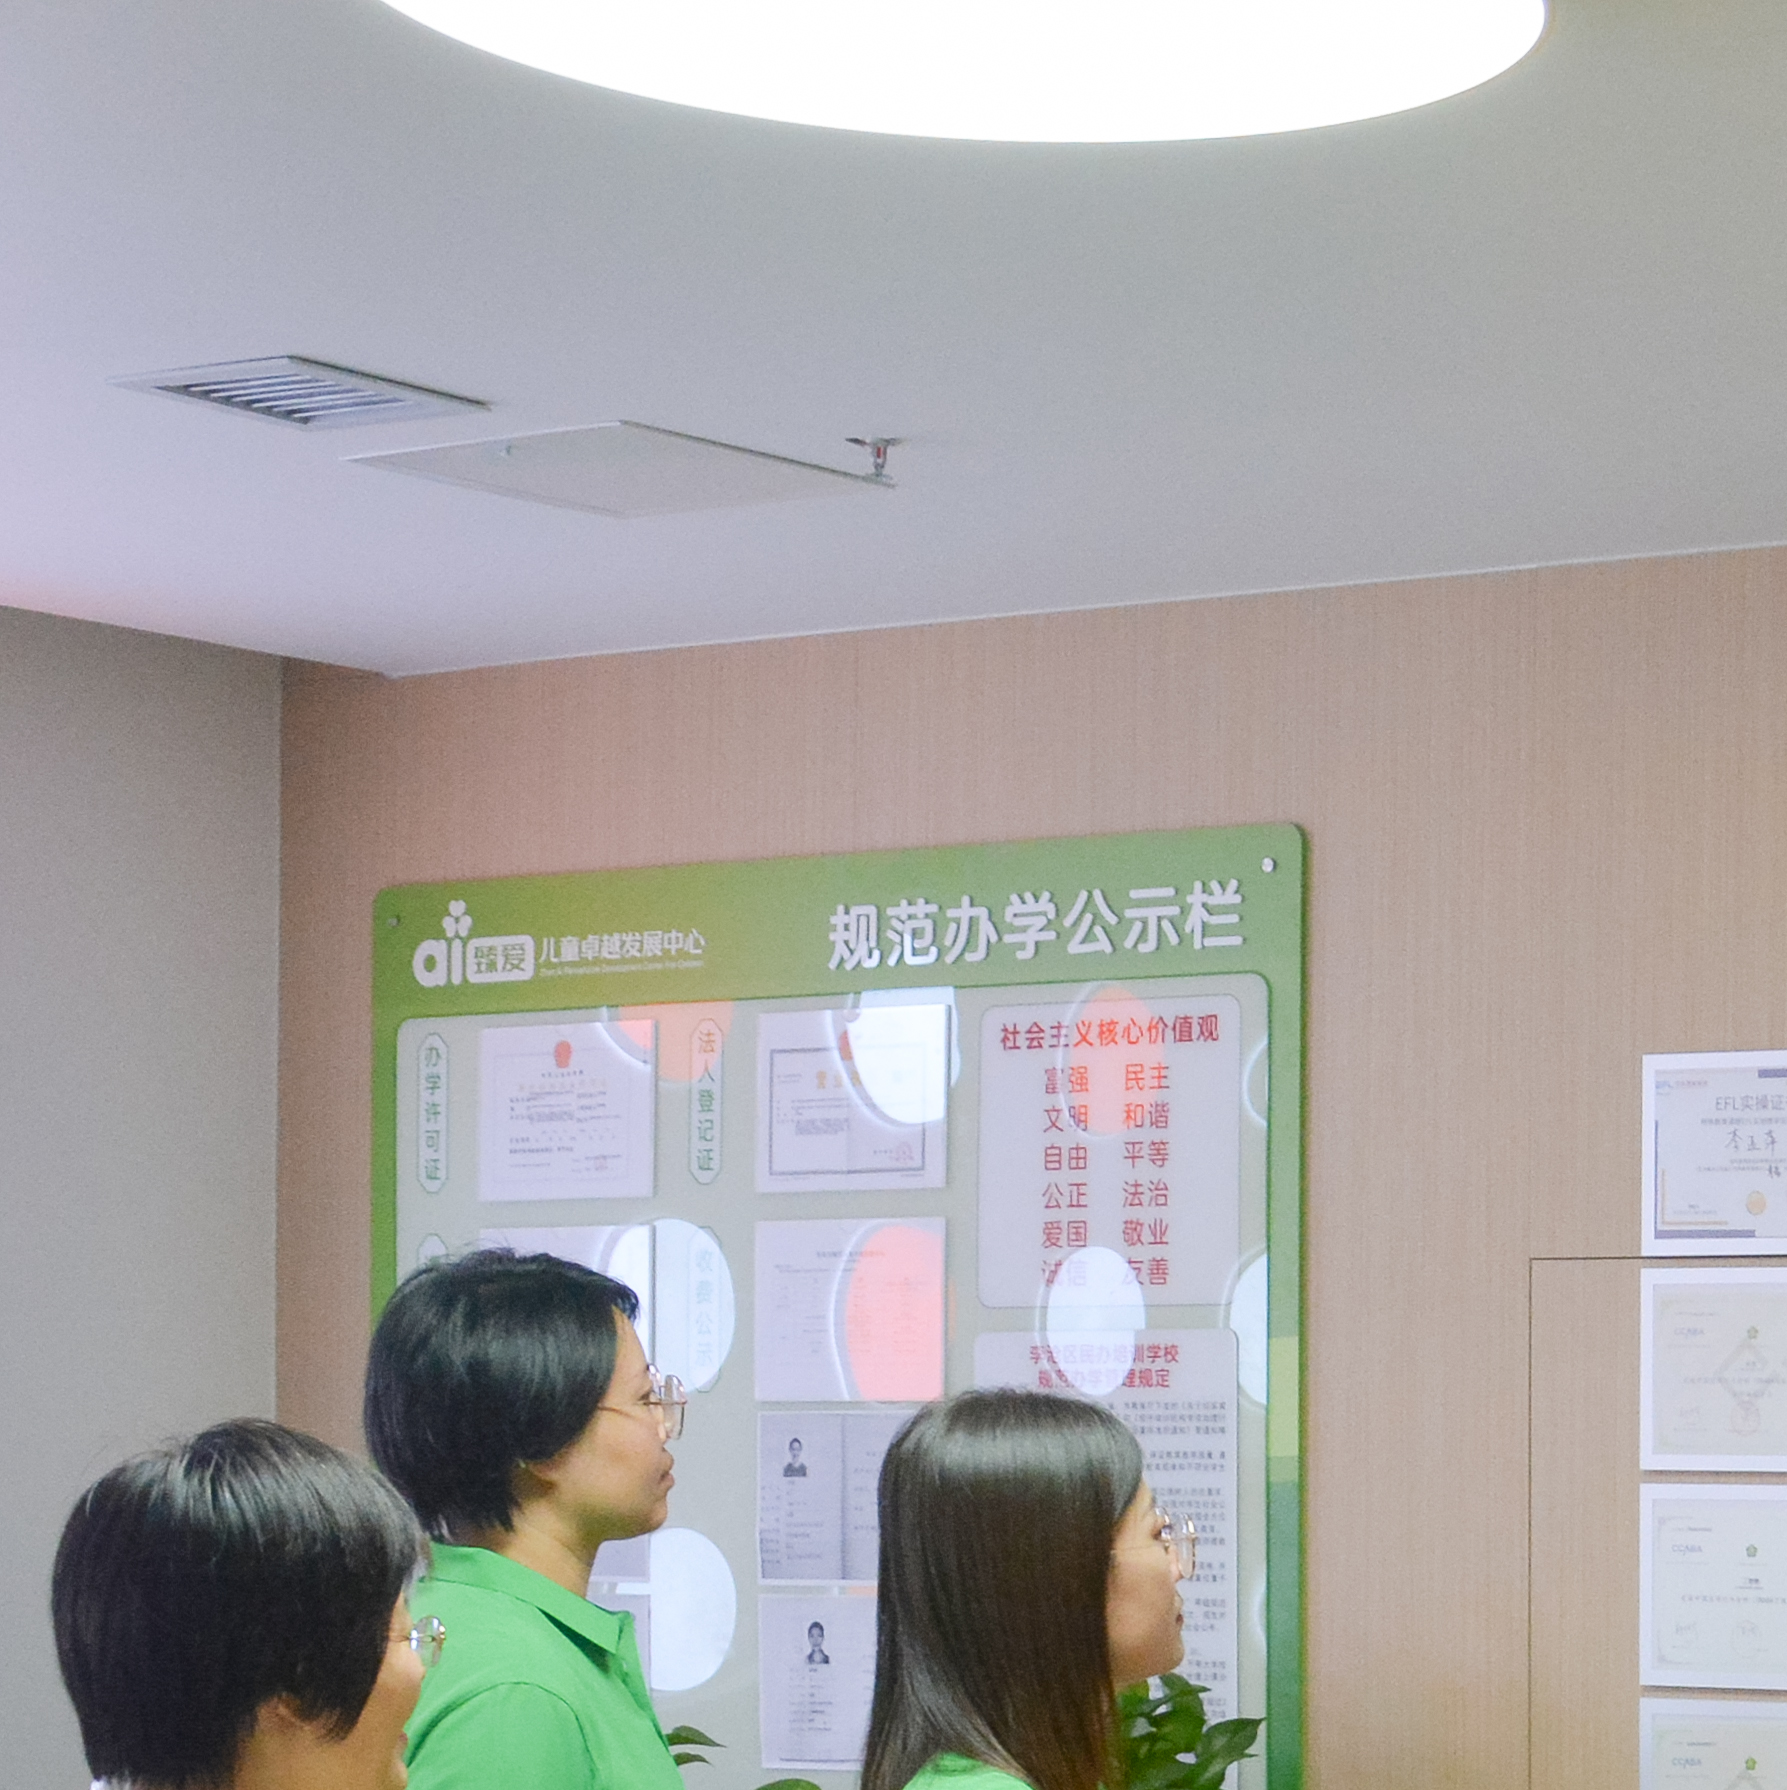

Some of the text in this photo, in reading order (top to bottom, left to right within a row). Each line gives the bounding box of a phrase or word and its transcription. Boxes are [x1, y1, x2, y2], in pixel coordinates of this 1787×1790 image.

[827, 878, 1244, 971] 规范办学公示栏
[538, 928, 706, 964] 儿童卓越发展中心
[999, 1013, 1221, 1051] 社会主义核心价值观
[1043, 1062, 1171, 1096] 富强 民主
[422, 1045, 443, 1182] 办学许可证
[696, 1029, 717, 1173] 法人登记证
[1042, 1100, 1171, 1133] 文明 和谐
[1042, 1140, 1171, 1173] 自由 平等
[1041, 1178, 1171, 1211] 公正 法治
[1041, 1217, 1171, 1250] 爱国 敬业
[1040, 1256, 1171, 1289] 诚信 友善
